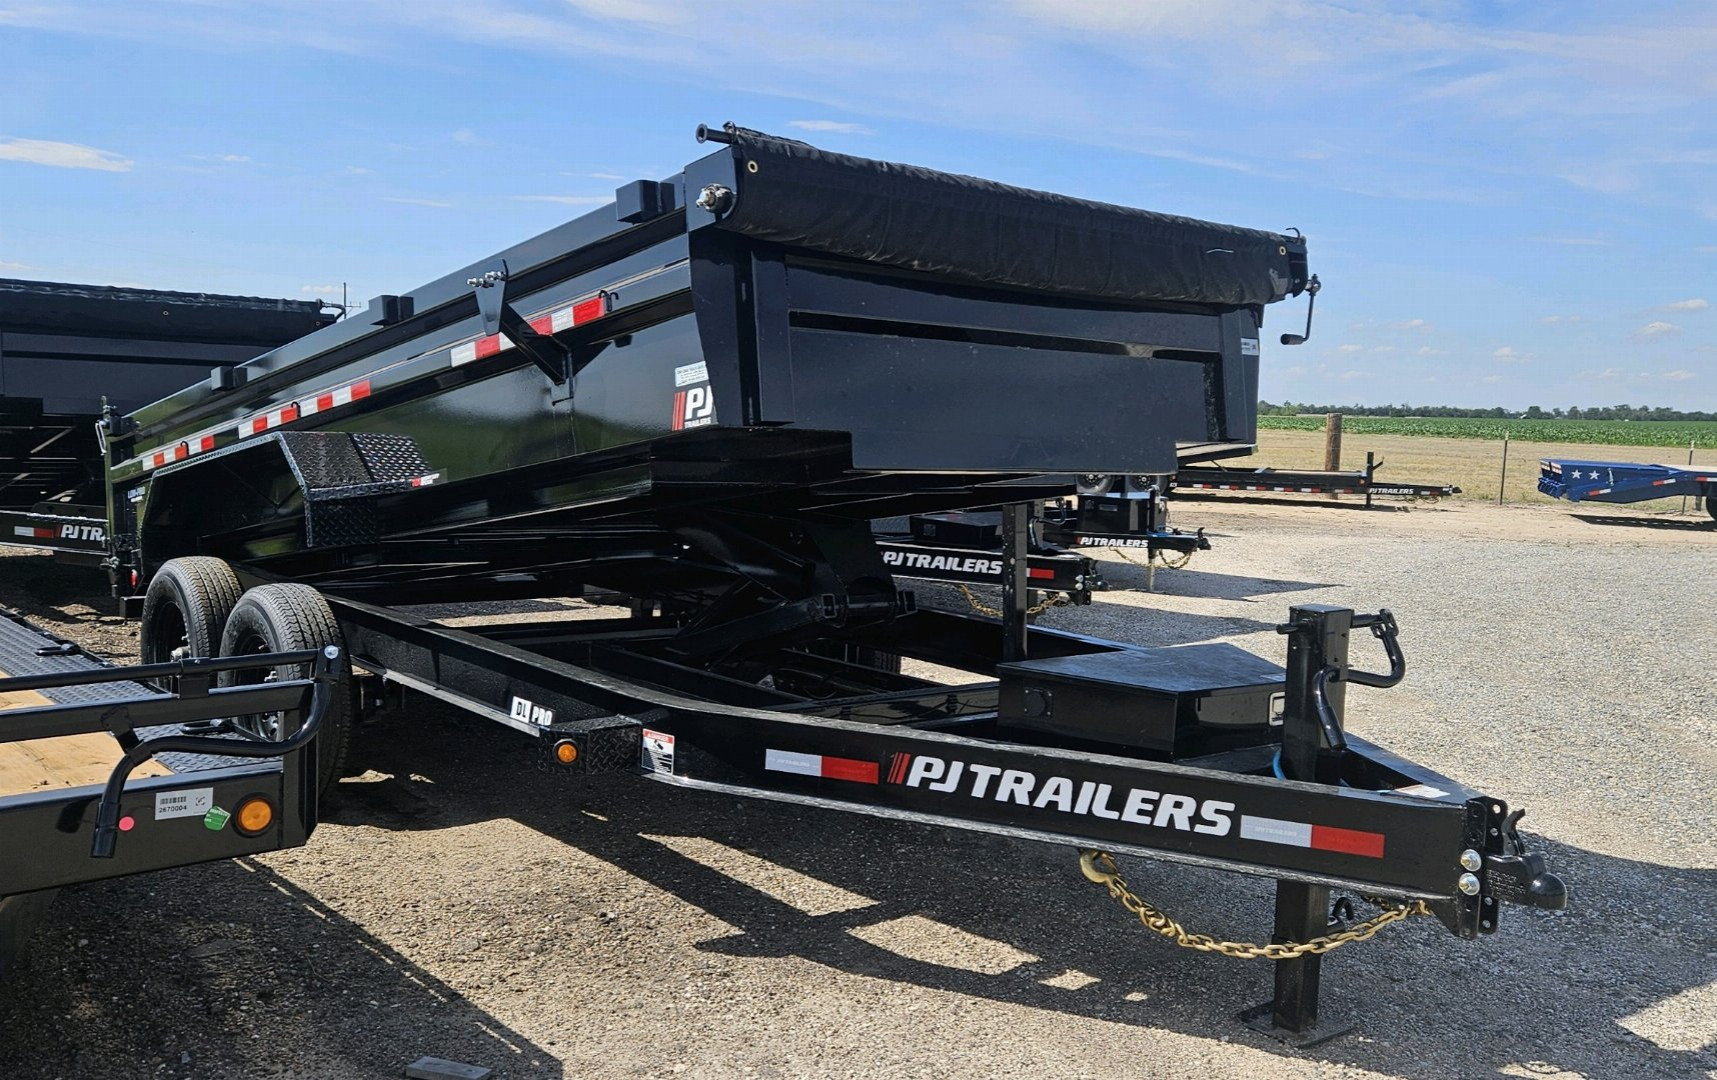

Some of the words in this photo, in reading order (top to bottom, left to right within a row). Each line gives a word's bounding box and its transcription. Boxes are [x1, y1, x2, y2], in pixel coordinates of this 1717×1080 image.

[685, 385, 713, 420] PJ
[684, 417, 712, 429] TRAILERS
[61, 524, 80, 539] PJ
[1080, 536, 1093, 546] PJ
[1093, 538, 1149, 548] TRAILERS
[883, 551, 904, 566] PJ
[906, 552, 1003, 575] TRAILERS
[516, 701, 526, 718] DL
[531, 705, 553, 726] PRO
[906, 755, 964, 793] PJ
[969, 764, 1236, 837] TRAILERS
